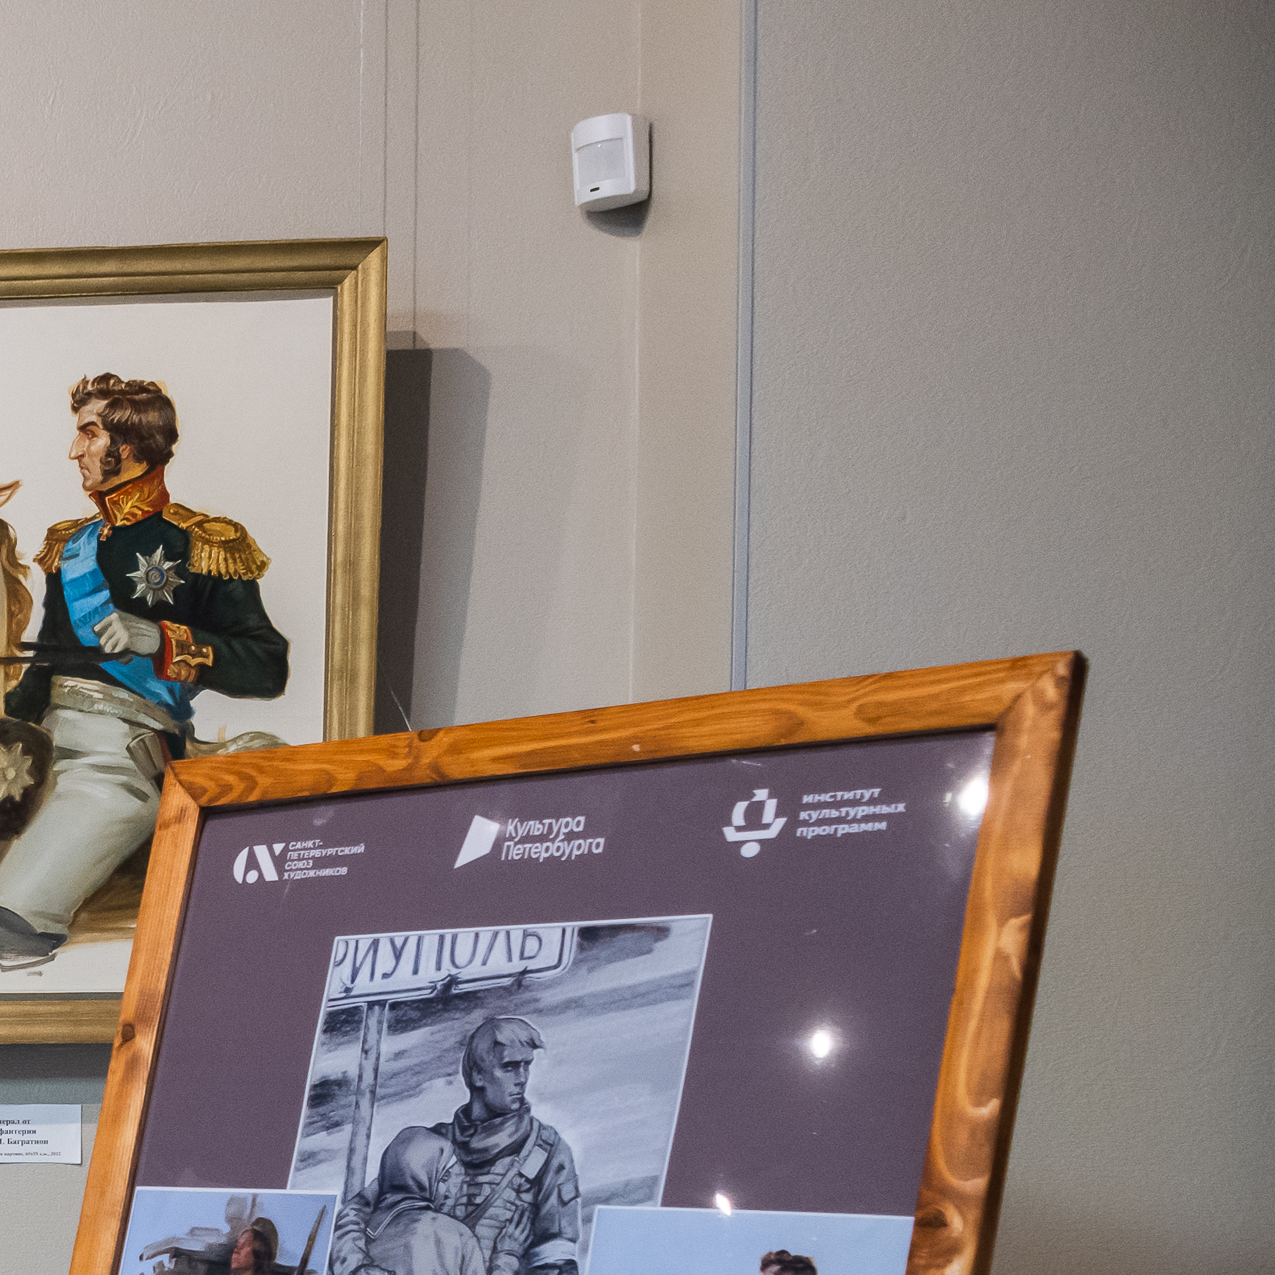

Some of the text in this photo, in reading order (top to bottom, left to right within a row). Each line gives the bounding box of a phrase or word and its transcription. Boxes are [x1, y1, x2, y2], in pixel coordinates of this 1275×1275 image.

[802, 788, 882, 804] институт
[798, 803, 907, 823] культурных
[505, 816, 586, 842] Культура
[796, 821, 888, 839] программ
[286, 843, 365, 860] ПЕТЕРБУРГСКИЙ
[288, 839, 324, 850] САНКТ-
[501, 834, 605, 862] Петербурга
[284, 860, 313, 870] СОЮЗ
[282, 867, 348, 880] ХУДОЖНИКОВ
[7, 1138, 49, 1146] Багратион
